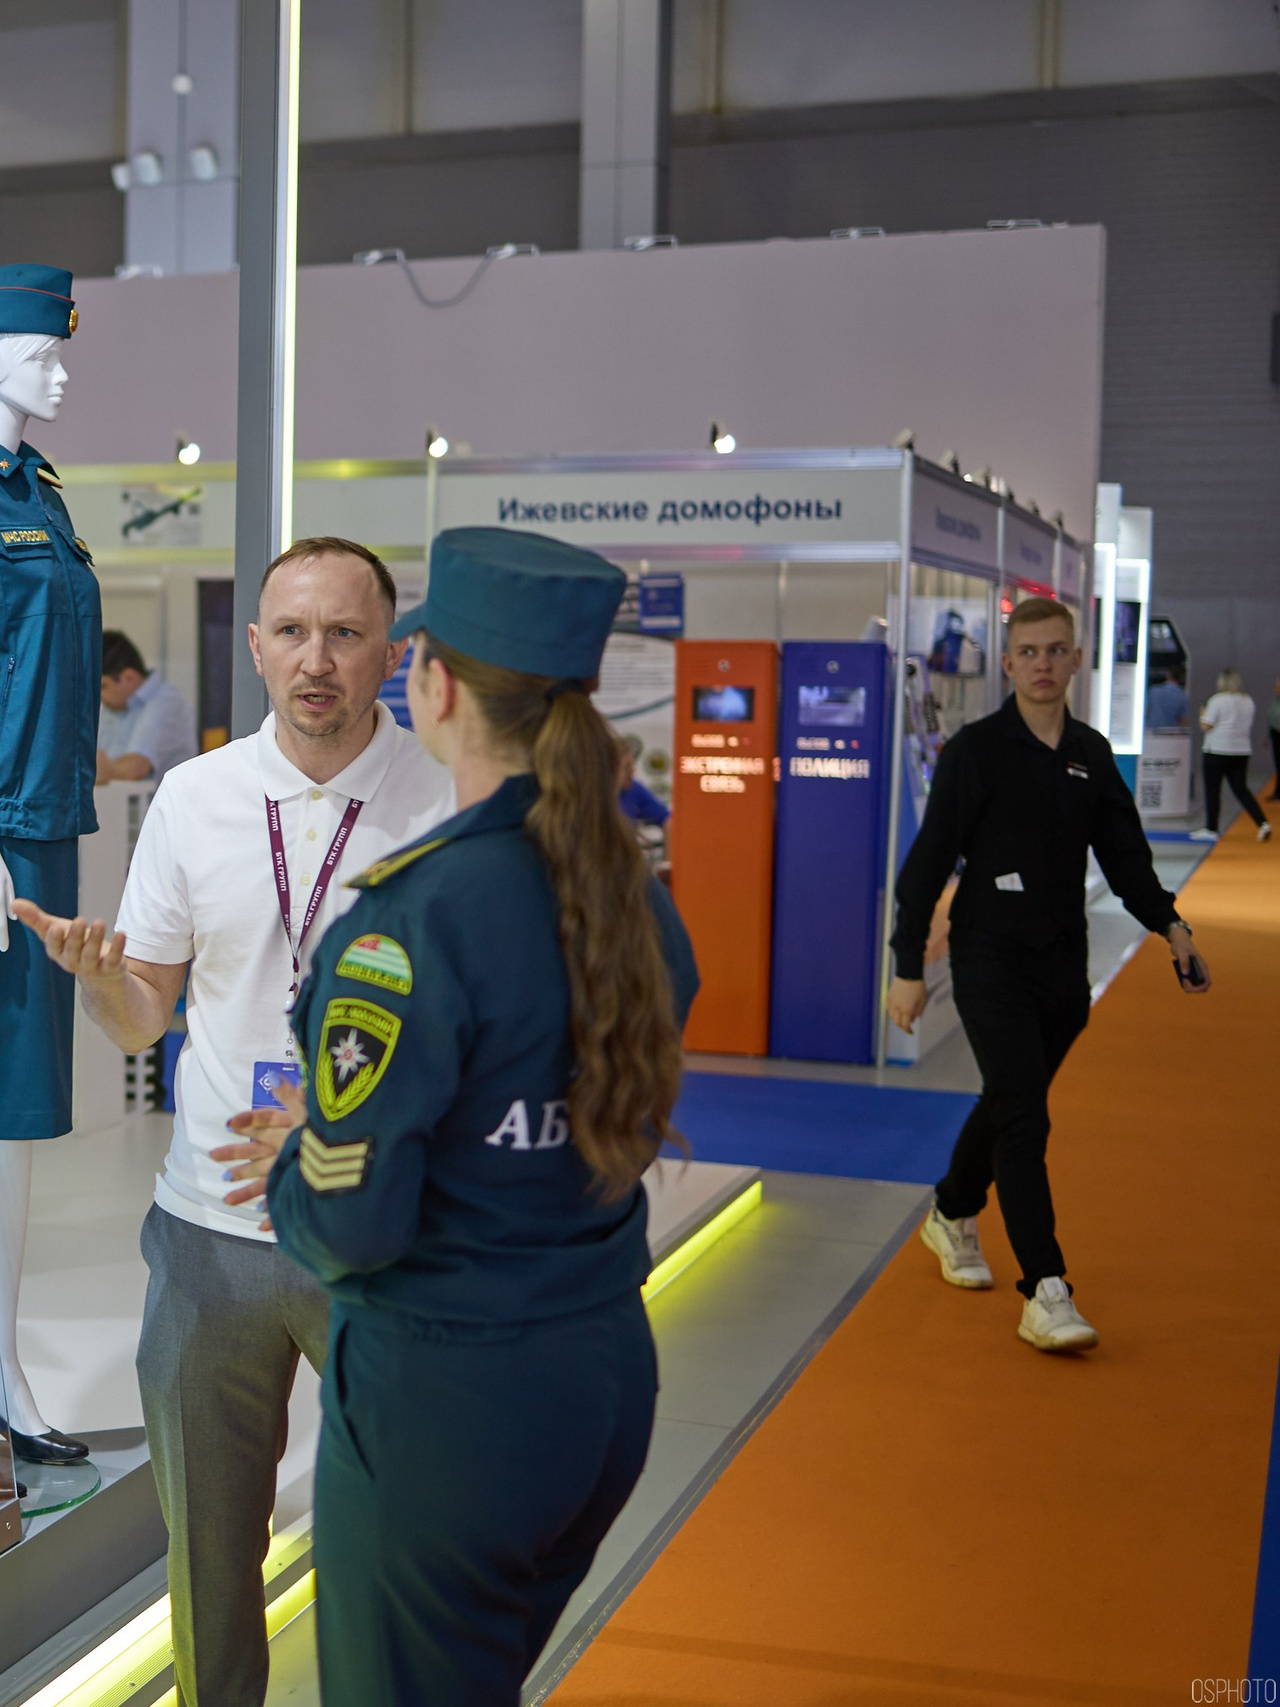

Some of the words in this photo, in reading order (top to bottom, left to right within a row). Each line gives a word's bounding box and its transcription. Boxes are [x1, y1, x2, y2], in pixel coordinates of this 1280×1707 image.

[498, 498, 650, 522] Ижевские
[657, 493, 842, 527] домофоны
[789, 757, 870, 779] ПОЛИЦИЯ
[326, 848, 338, 866] БТК
[333, 827, 348, 850] ГРУПП
[275, 851, 284, 867] БТК
[278, 867, 287, 891] ГРУПП
[308, 886, 323, 910] ГРУПП
[304, 909, 314, 926] БТК
[484, 1099, 570, 1150] АБ
